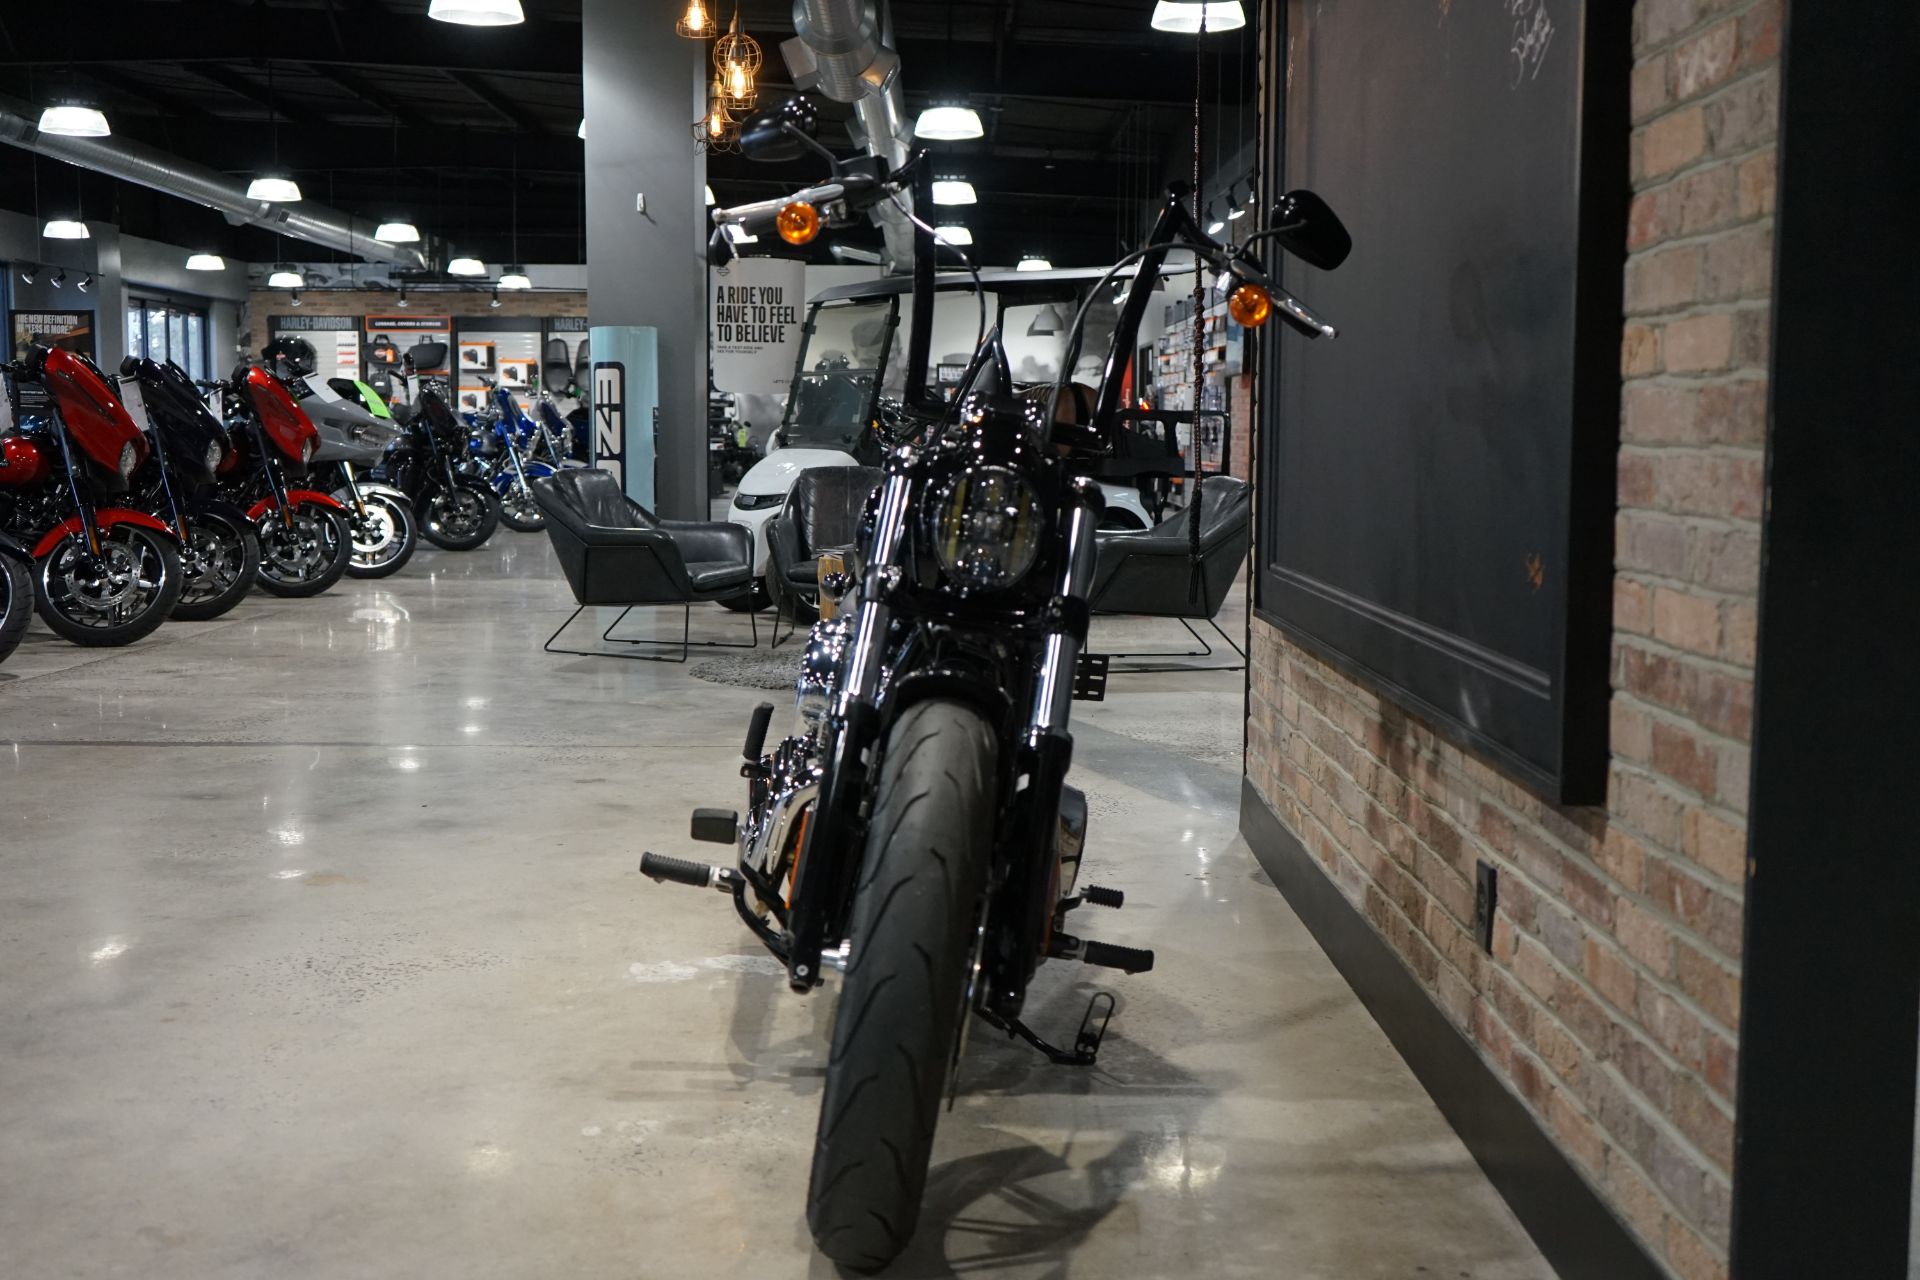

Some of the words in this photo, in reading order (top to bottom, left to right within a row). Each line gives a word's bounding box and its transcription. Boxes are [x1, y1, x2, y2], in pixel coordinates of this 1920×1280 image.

[717, 285, 725, 304] A
[728, 286, 756, 305] RIDE
[759, 286, 783, 305] YOU
[29, 314, 44, 324] NEW
[43, 314, 78, 325] DEFINITION
[280, 316, 352, 330] HARLEY-DAVIDSON
[717, 305, 748, 323] HAVE
[751, 306, 766, 324] TO
[770, 306, 797, 325] FEEL
[43, 324, 51, 334] IS
[717, 324, 732, 343] TO
[736, 324, 785, 344] BELIEVE
